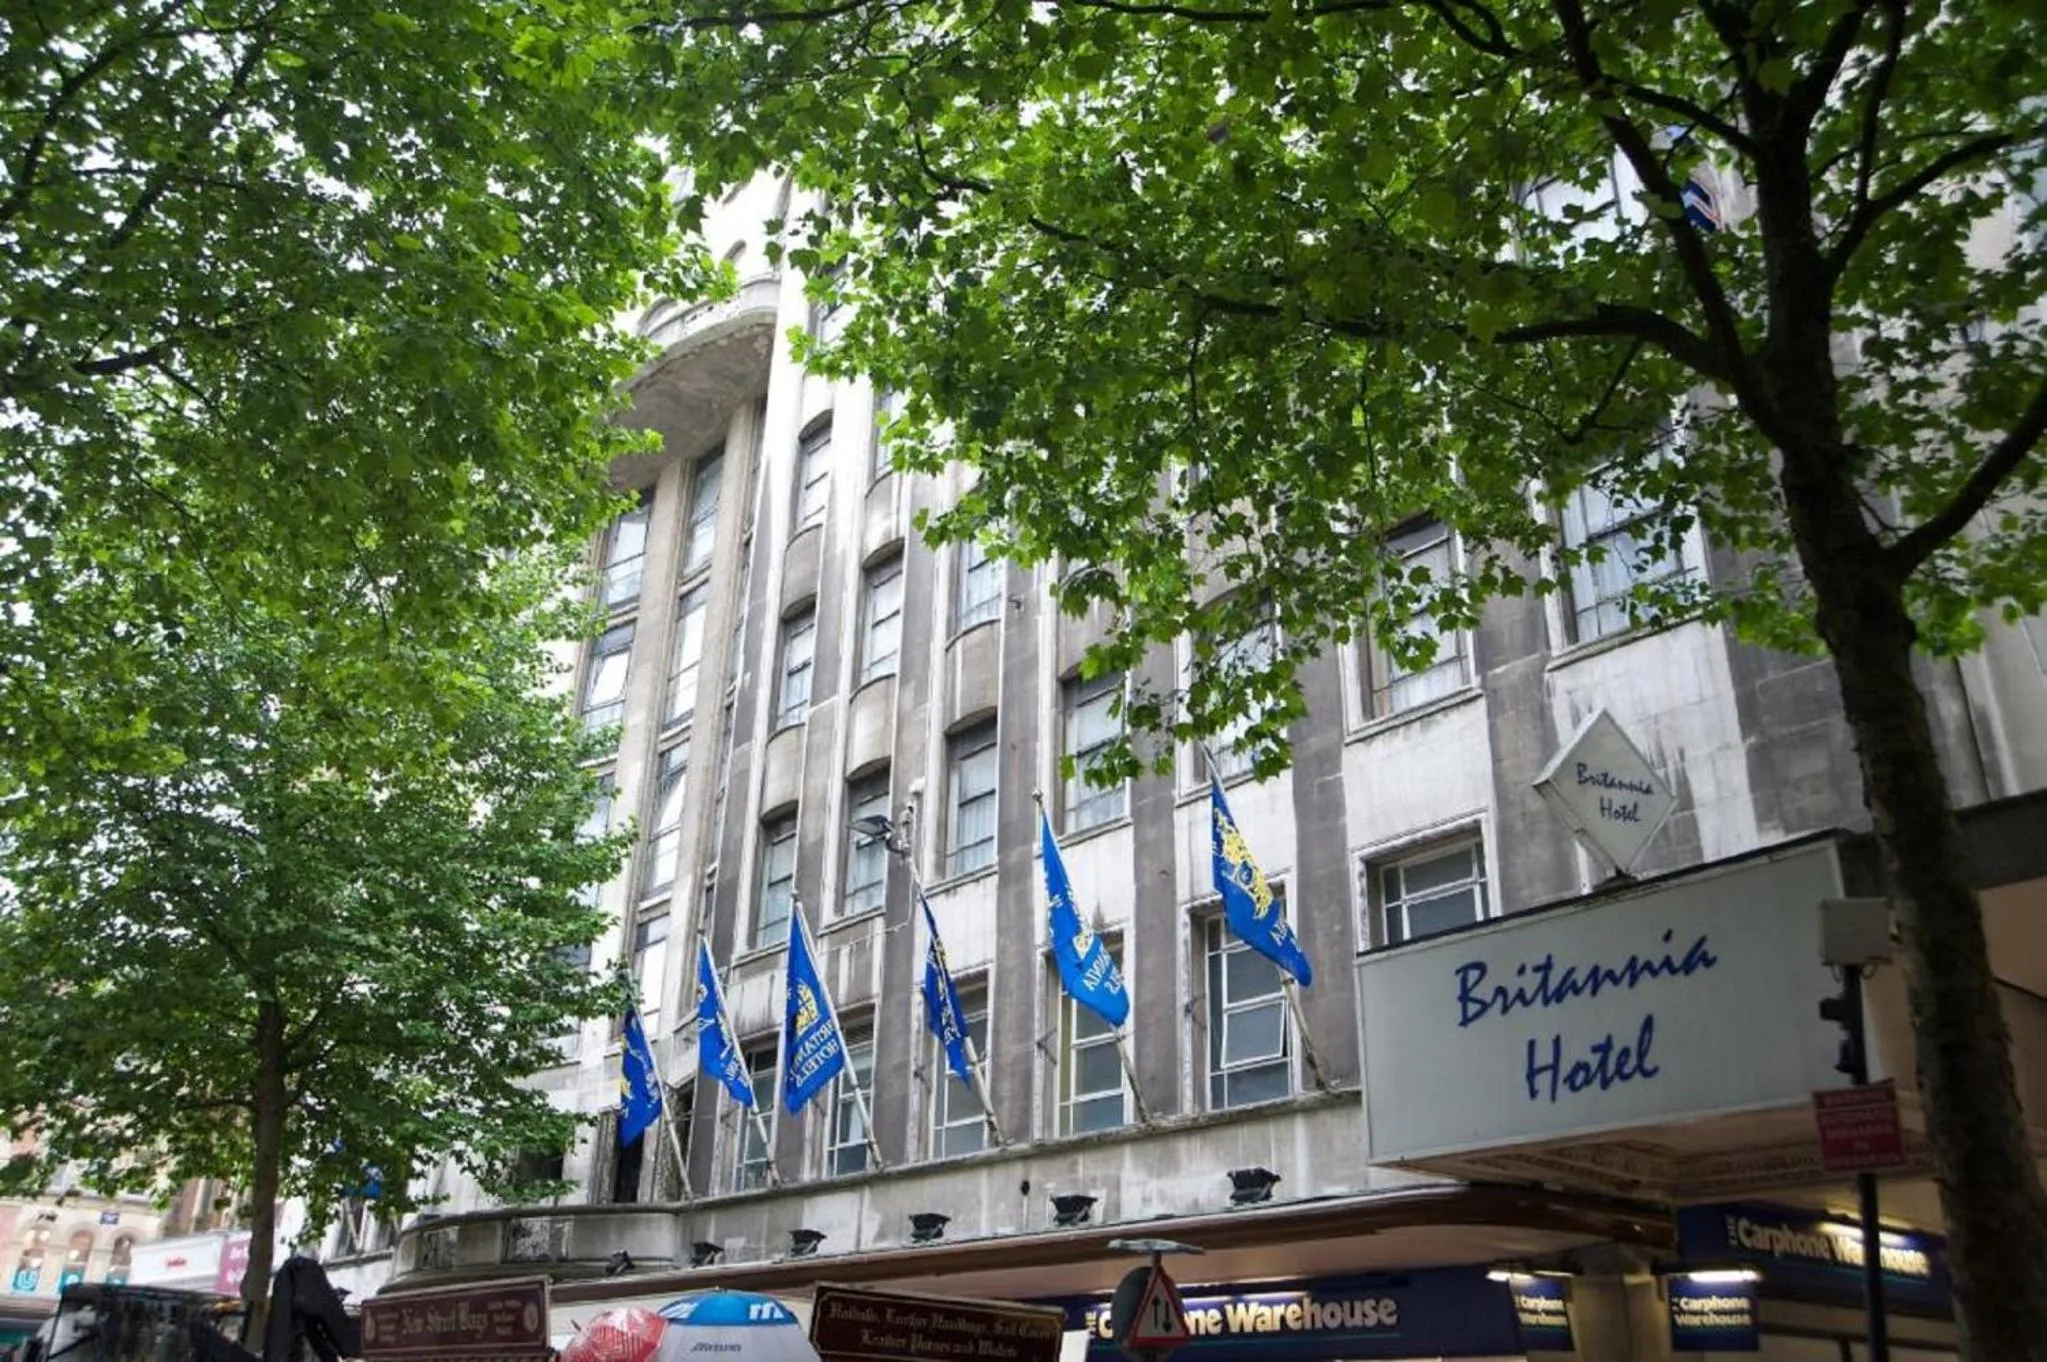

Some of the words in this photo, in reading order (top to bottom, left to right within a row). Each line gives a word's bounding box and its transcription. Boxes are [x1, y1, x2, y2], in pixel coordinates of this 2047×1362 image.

[1575, 762, 1655, 796] Britannia
[1599, 796, 1641, 823] Hotel
[1454, 928, 1718, 1028] Britannia
[1525, 1014, 1660, 1103] Hotel
[1737, 1216, 1832, 1260] Carphone
[1223, 1296, 1398, 1335] Warehouse
[1679, 1295, 1750, 1313] Carphone
